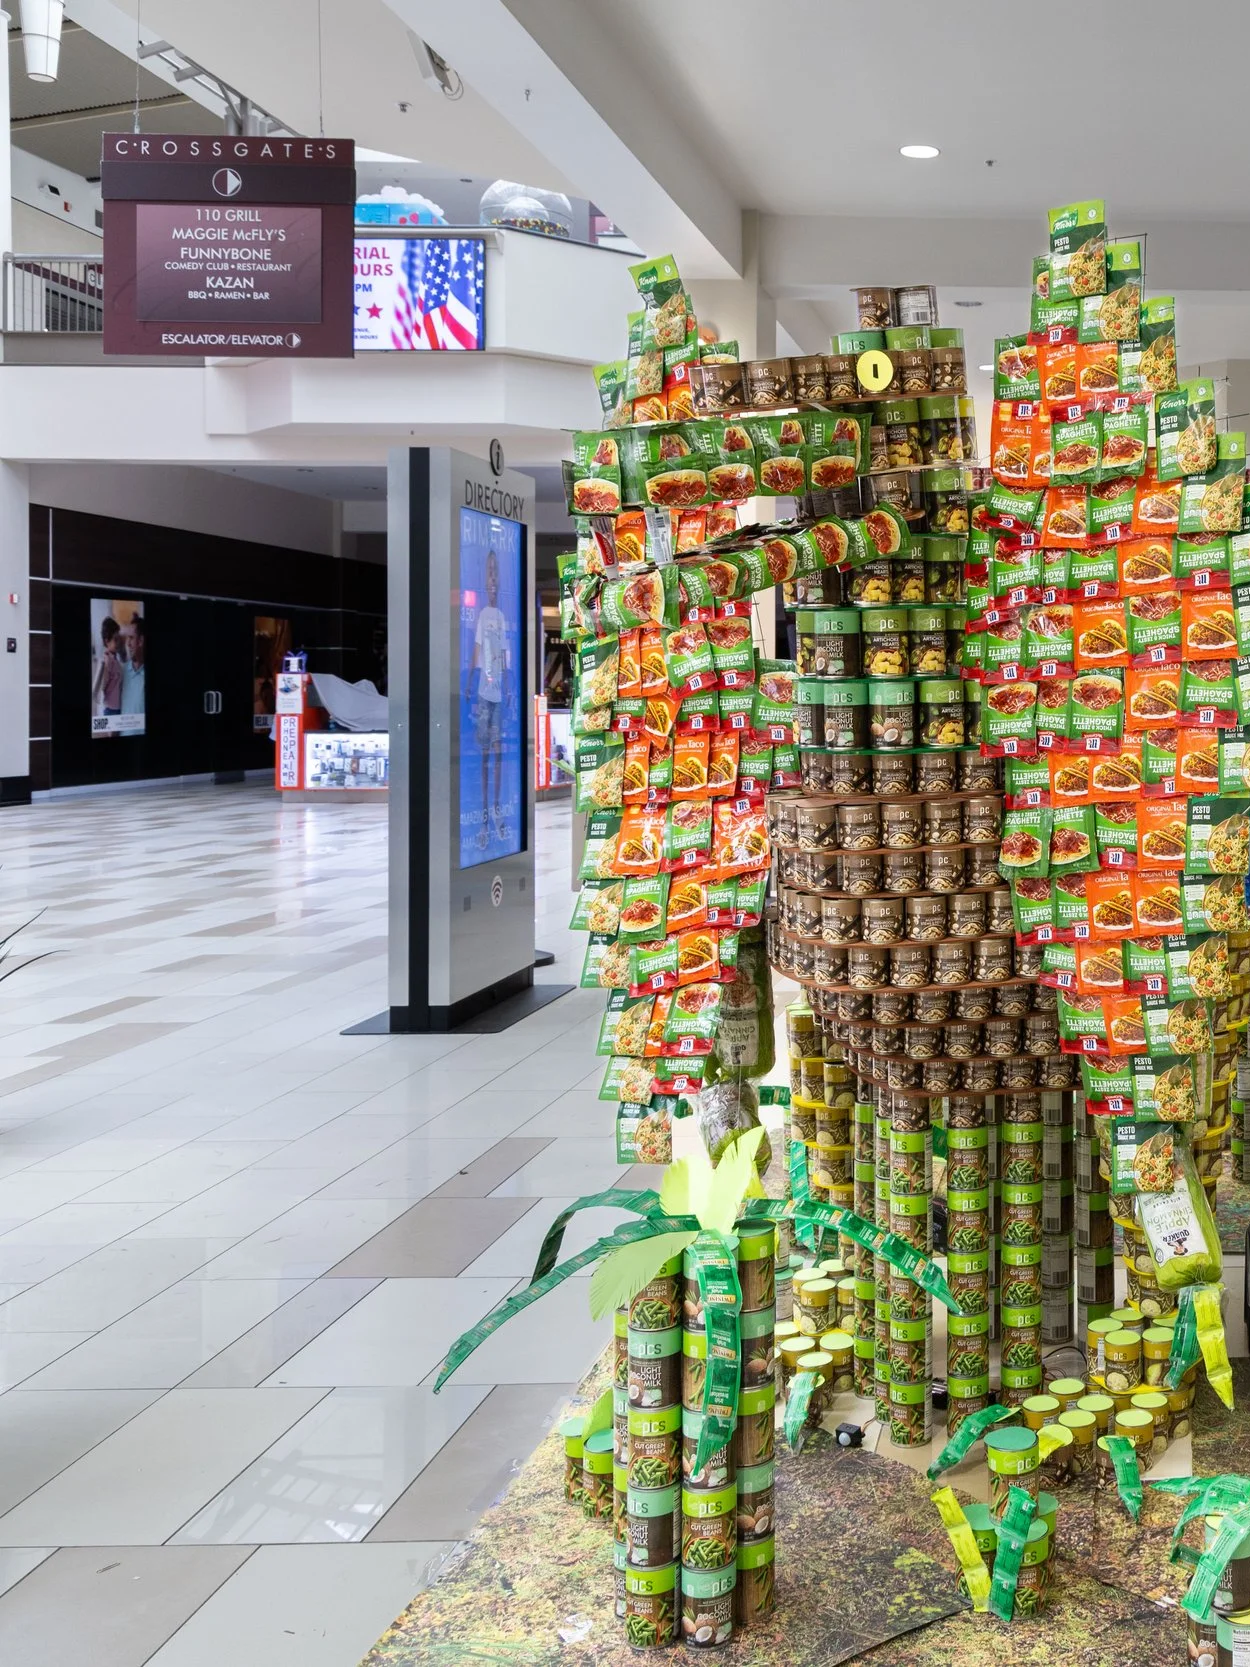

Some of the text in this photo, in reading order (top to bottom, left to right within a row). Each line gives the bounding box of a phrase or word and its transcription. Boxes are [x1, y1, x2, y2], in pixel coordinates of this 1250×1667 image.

[196, 209, 261, 221] 110 GRILL
[1054, 218, 1077, 233] Knorr
[173, 228, 286, 241] MAGGIE McFLY'S
[181, 248, 271, 260] FUNNYBONE
[165, 262, 292, 271] COMEDY CLUB RESTAURANT
[206, 277, 254, 288] KAZAN
[356, 284, 372, 292] PM
[188, 291, 206, 299] BBQ
[162, 334, 283, 345] ESCALATOR/ELEVATOR
[1000, 383, 1039, 393] SPAGHETTI
[1160, 399, 1187, 410] Knorr
[1160, 416, 1177, 425] PESTO
[465, 479, 525, 520] DIRECTORY
[1093, 504, 1133, 518] SPAGHETTI
[1179, 550, 1225, 560] SPAGHETTI
[1072, 562, 1115, 574] SPAGHETTI
[1104, 601, 1124, 610] Taco
[824, 619, 843, 632] pics
[1134, 626, 1180, 638] SPAGHETTI
[581, 640, 599, 649] Knorr
[1028, 643, 1072, 653] SPAGHETTI
[1160, 662, 1180, 671] Taco
[833, 691, 853, 704] pics
[1186, 689, 1233, 698] SPAGHETTI
[1073, 717, 1116, 726] SPAGHETTI
[580, 739, 604, 748] Knorr
[688, 740, 704, 748] Taco
[1124, 734, 1143, 743] Taco
[633, 745, 647, 753] Taco
[1192, 805, 1210, 814] PESTO
[626, 885, 660, 895] SPAGHETTI
[665, 1059, 703, 1067] SPAGHETTI
[1118, 1126, 1135, 1134] PESTO
[1016, 1130, 1034, 1143] pics
[962, 1198, 980, 1212] pics
[1156, 1216, 1190, 1234] APPLE
[1163, 1230, 1190, 1242] QUAKER
[966, 1260, 983, 1273] pics
[646, 1284, 668, 1293] GREEN
[648, 1290, 668, 1298] BEANS
[1018, 1313, 1035, 1326] pics
[963, 1321, 982, 1335] pics
[637, 1342, 662, 1357] pics
[963, 1383, 982, 1396] pics
[642, 1421, 666, 1436] pics
[699, 1500, 723, 1515] pics
[631, 1578, 653, 1594] pics
[712, 1577, 732, 1594] pics
